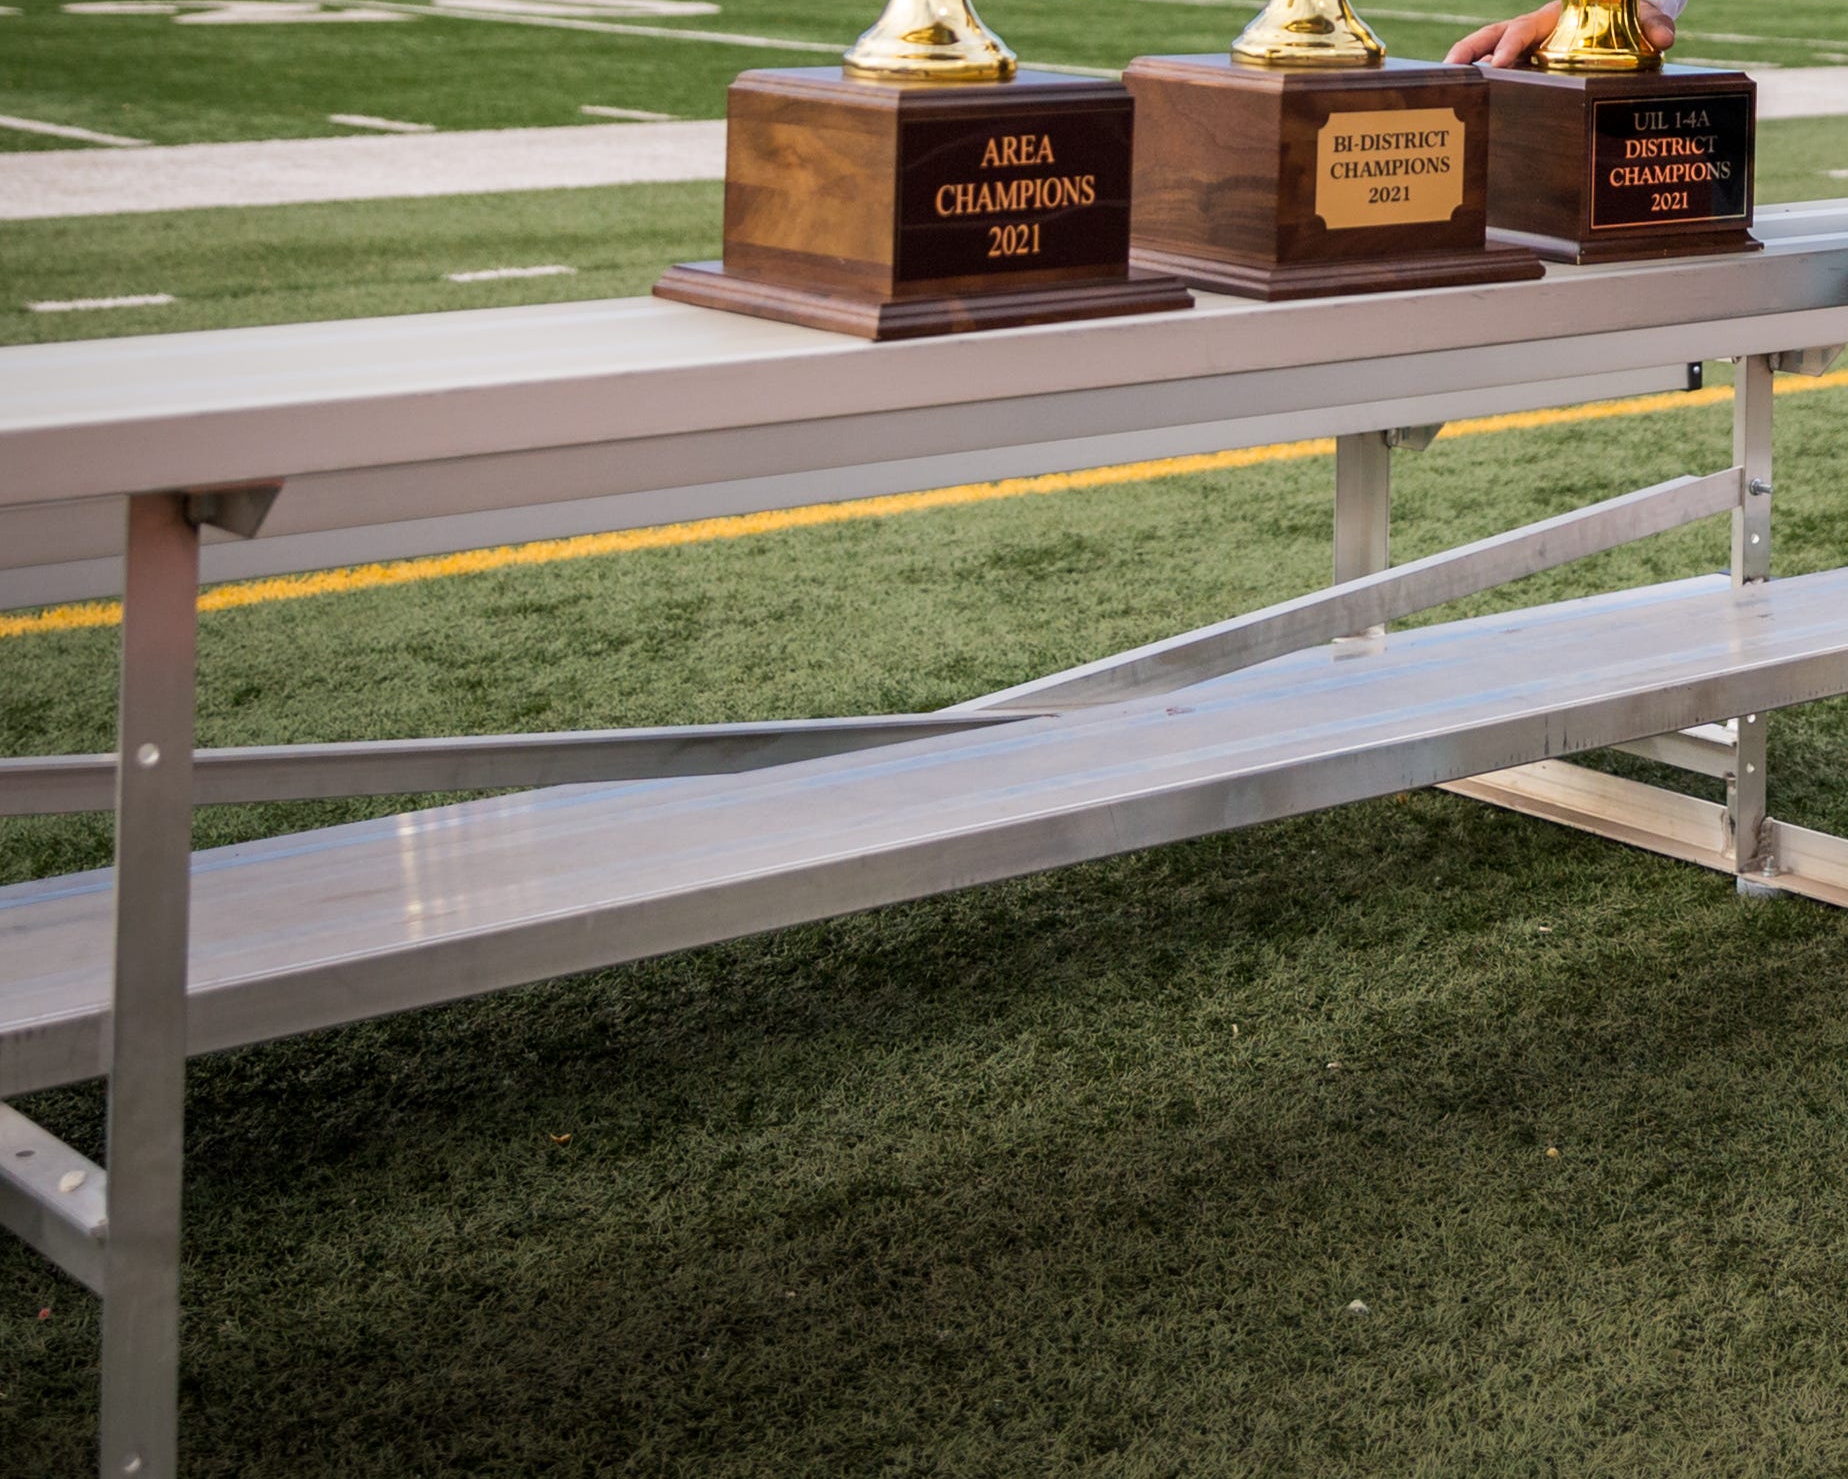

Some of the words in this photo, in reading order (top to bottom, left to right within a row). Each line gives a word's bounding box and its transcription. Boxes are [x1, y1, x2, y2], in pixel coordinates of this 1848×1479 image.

[1634, 111, 1669, 131] UIL
[980, 134, 1055, 170] AREA
[1333, 130, 1449, 153] BI-DISTRICT
[1625, 135, 1718, 159] DISTRICT
[1330, 156, 1450, 180] CHAMPIONS
[1609, 161, 1731, 187] CHAMPIONS
[935, 174, 1096, 217] CHAMPIONS
[1368, 185, 1410, 204] 2021
[1651, 191, 1689, 211] 2021
[987, 223, 1041, 258] 2021
